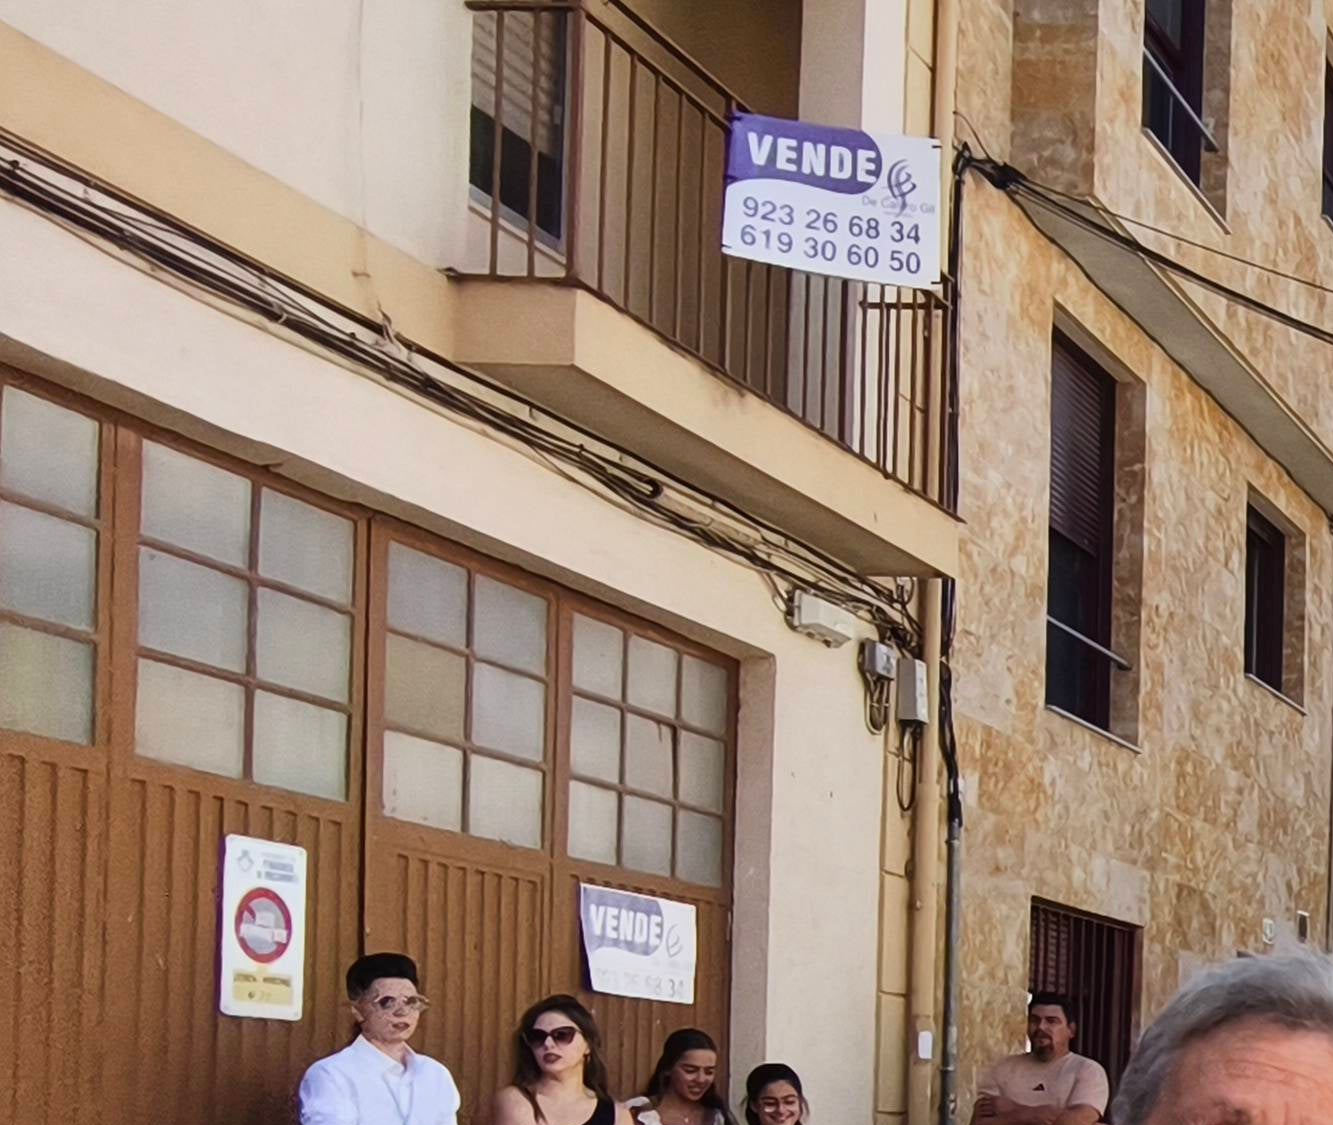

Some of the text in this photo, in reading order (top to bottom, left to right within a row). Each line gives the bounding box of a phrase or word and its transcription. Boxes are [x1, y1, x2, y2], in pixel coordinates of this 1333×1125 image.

[747, 131, 877, 183] VENDE
[742, 196, 921, 245] 923 26 68 34
[740, 224, 921, 275] 619 30 60 50
[590, 903, 662, 947] VENDE
